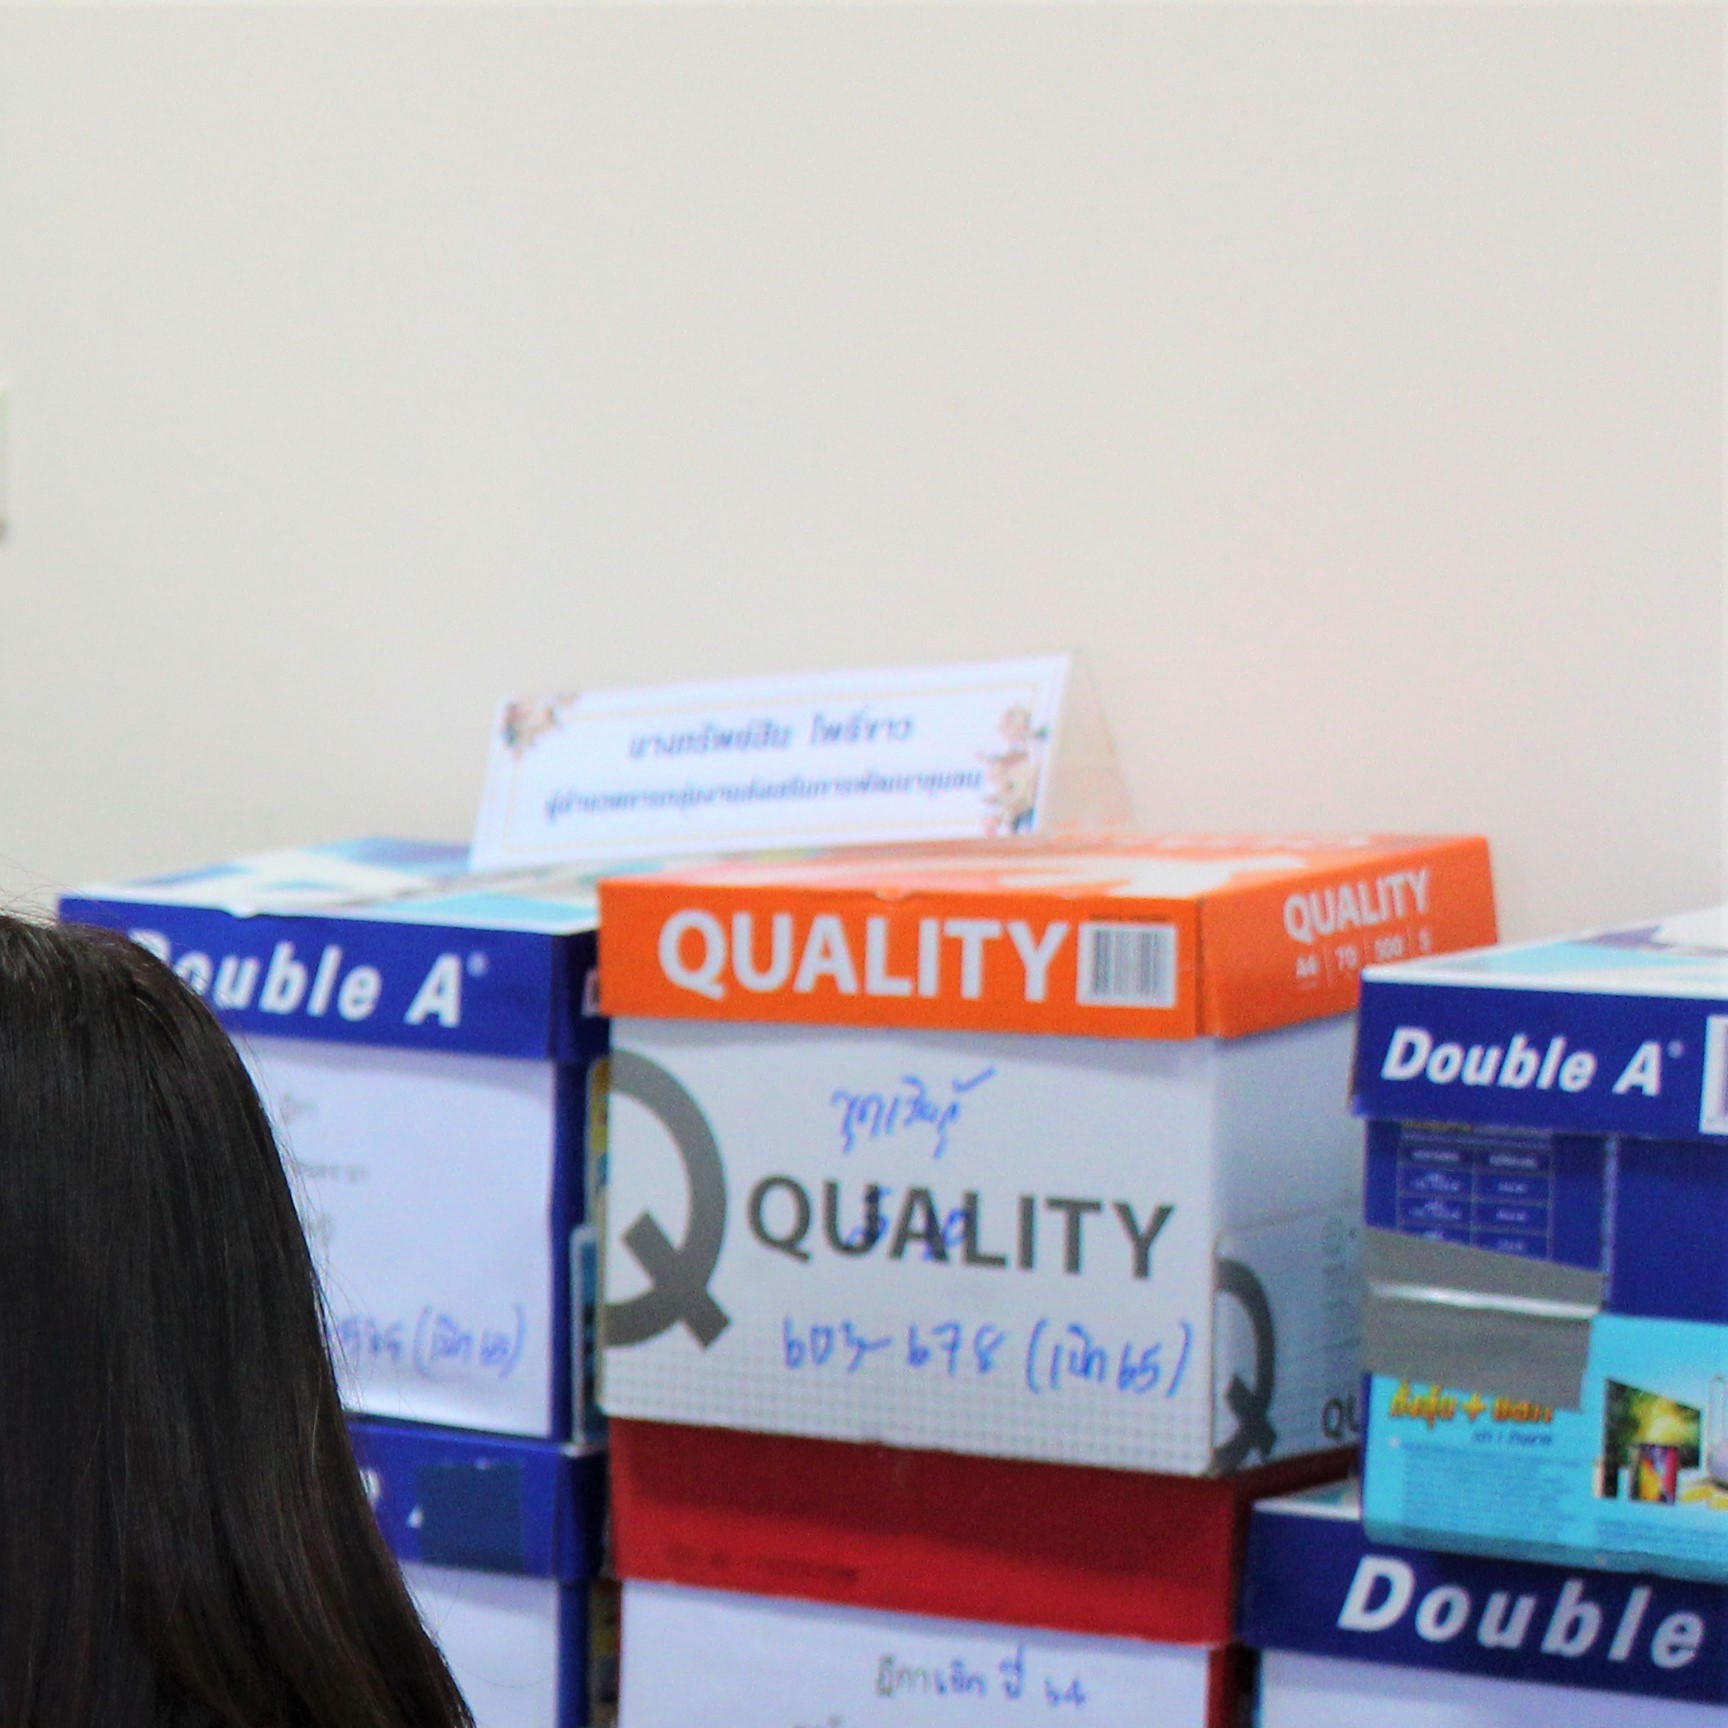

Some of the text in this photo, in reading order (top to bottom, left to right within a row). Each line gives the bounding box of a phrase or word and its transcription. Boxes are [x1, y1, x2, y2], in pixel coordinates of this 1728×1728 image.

[1282, 868, 1430, 944] QUALITY
[403, 952, 463, 1029] A
[657, 907, 1067, 1001] QUALITY
[1380, 1026, 1663, 1097] Double A
[748, 1175, 1175, 1281] QUALITY
[1337, 1554, 1705, 1670] Double
